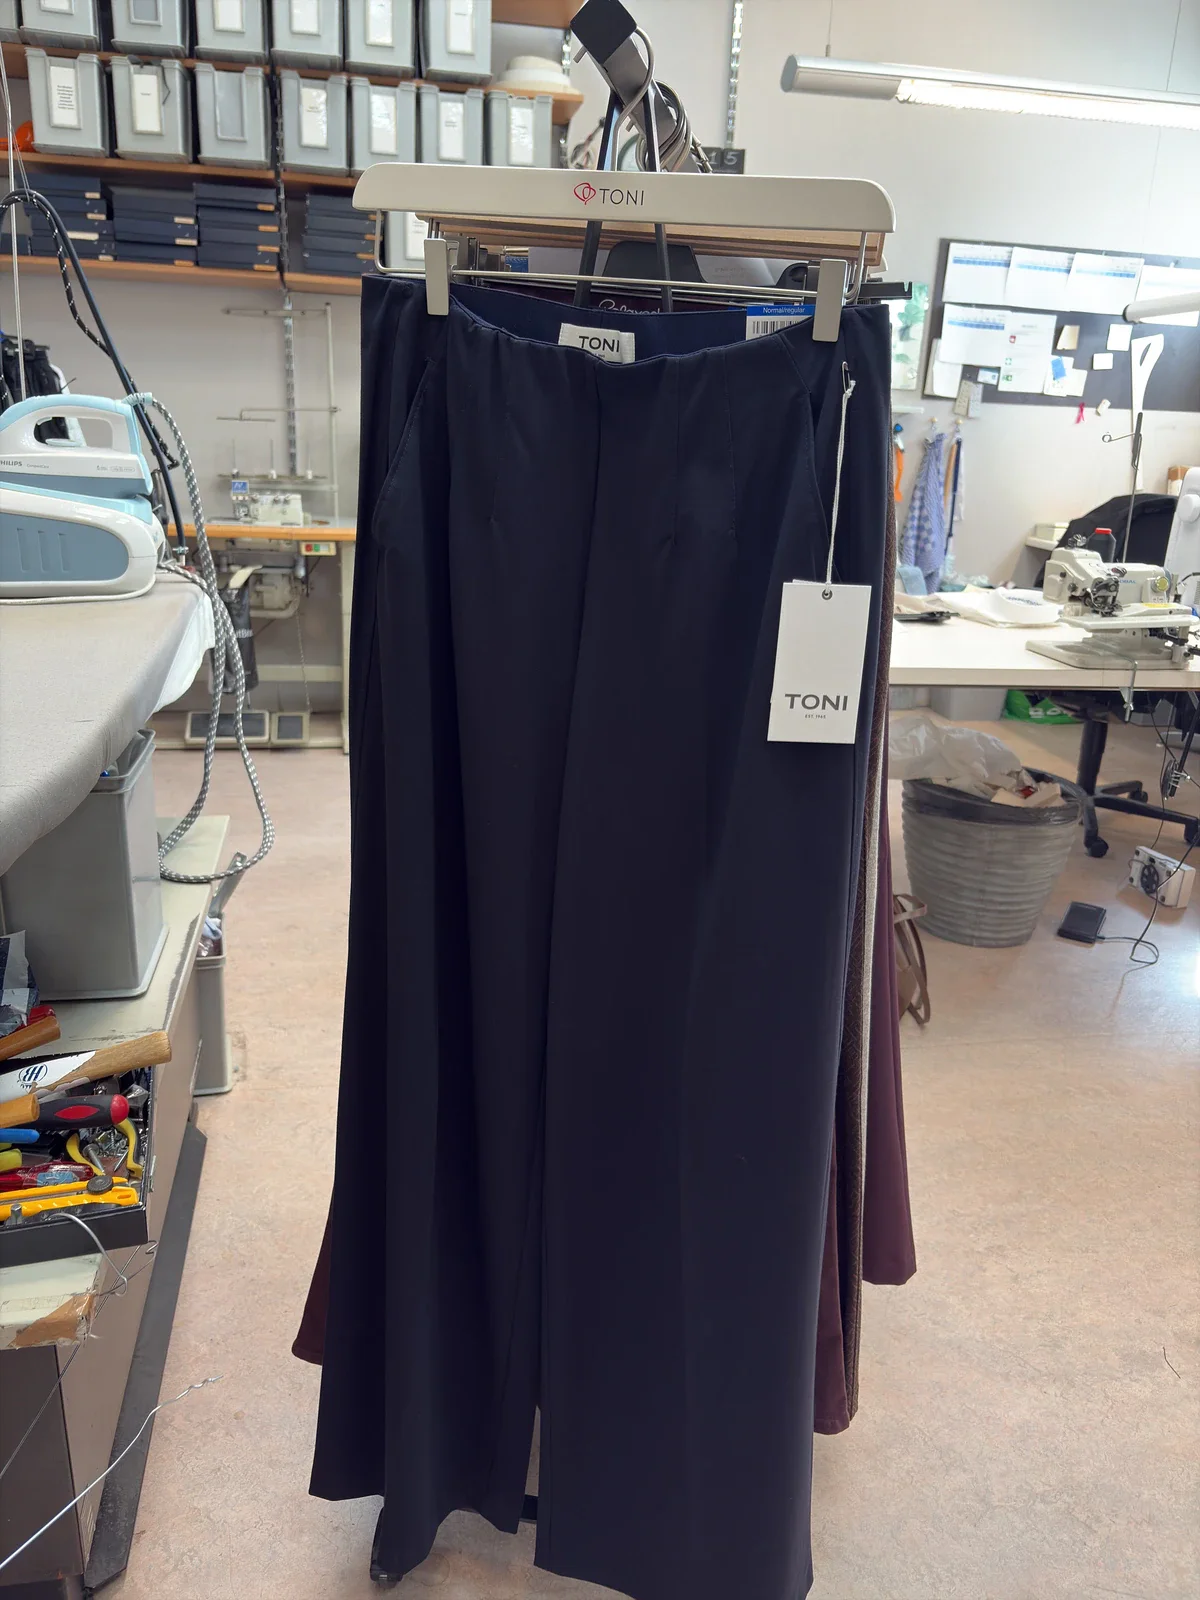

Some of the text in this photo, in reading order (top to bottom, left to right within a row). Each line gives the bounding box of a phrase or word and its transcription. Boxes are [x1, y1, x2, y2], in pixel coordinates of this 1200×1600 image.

[599, 188, 644, 206] TONI
[762, 307, 806, 315] Normal/regular
[578, 335, 620, 353] TONI
[784, 693, 849, 711] TONI
